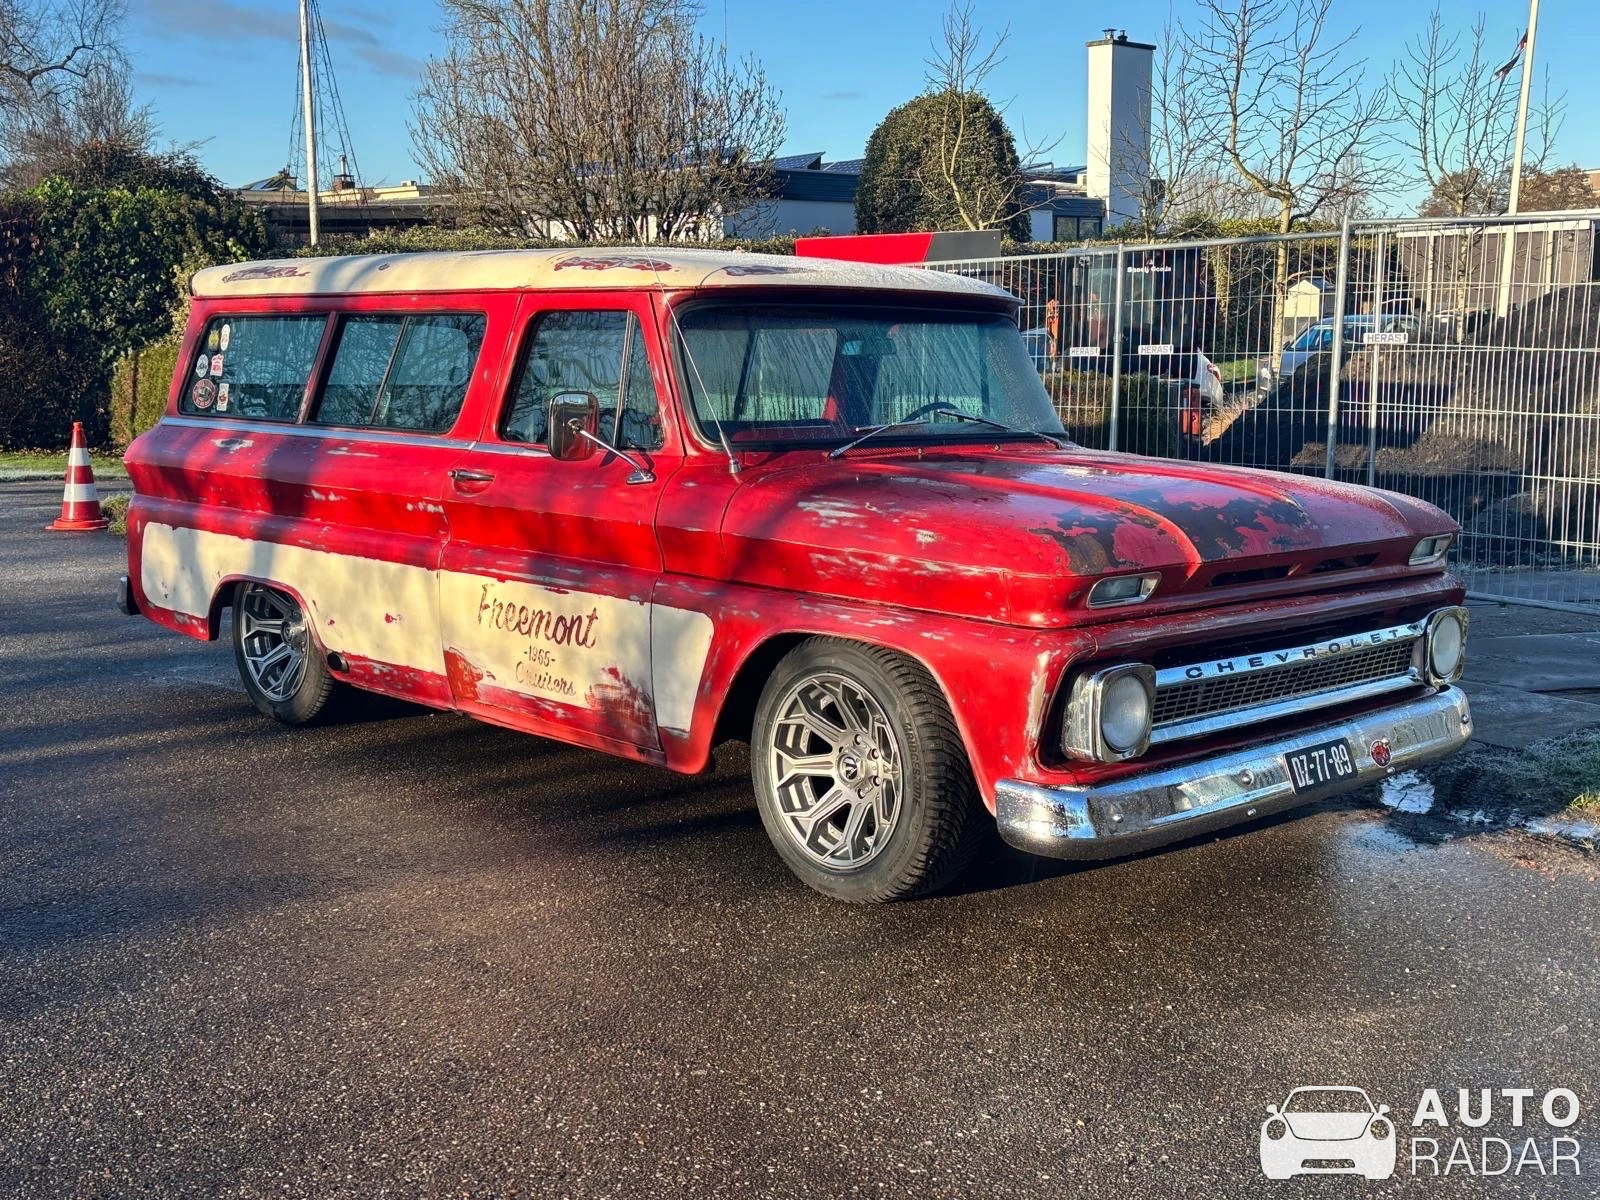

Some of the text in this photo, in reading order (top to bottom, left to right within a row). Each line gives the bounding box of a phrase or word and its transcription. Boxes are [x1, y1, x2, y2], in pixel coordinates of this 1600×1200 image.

[1071, 347, 1095, 356] HERAS
[1140, 345, 1168, 354] HERAS
[1367, 333, 1402, 343] HERAS
[477, 583, 599, 649] Freemont
[1185, 629, 1401, 679] CHEVROLET
[1291, 743, 1352, 788] DZ-77-89
